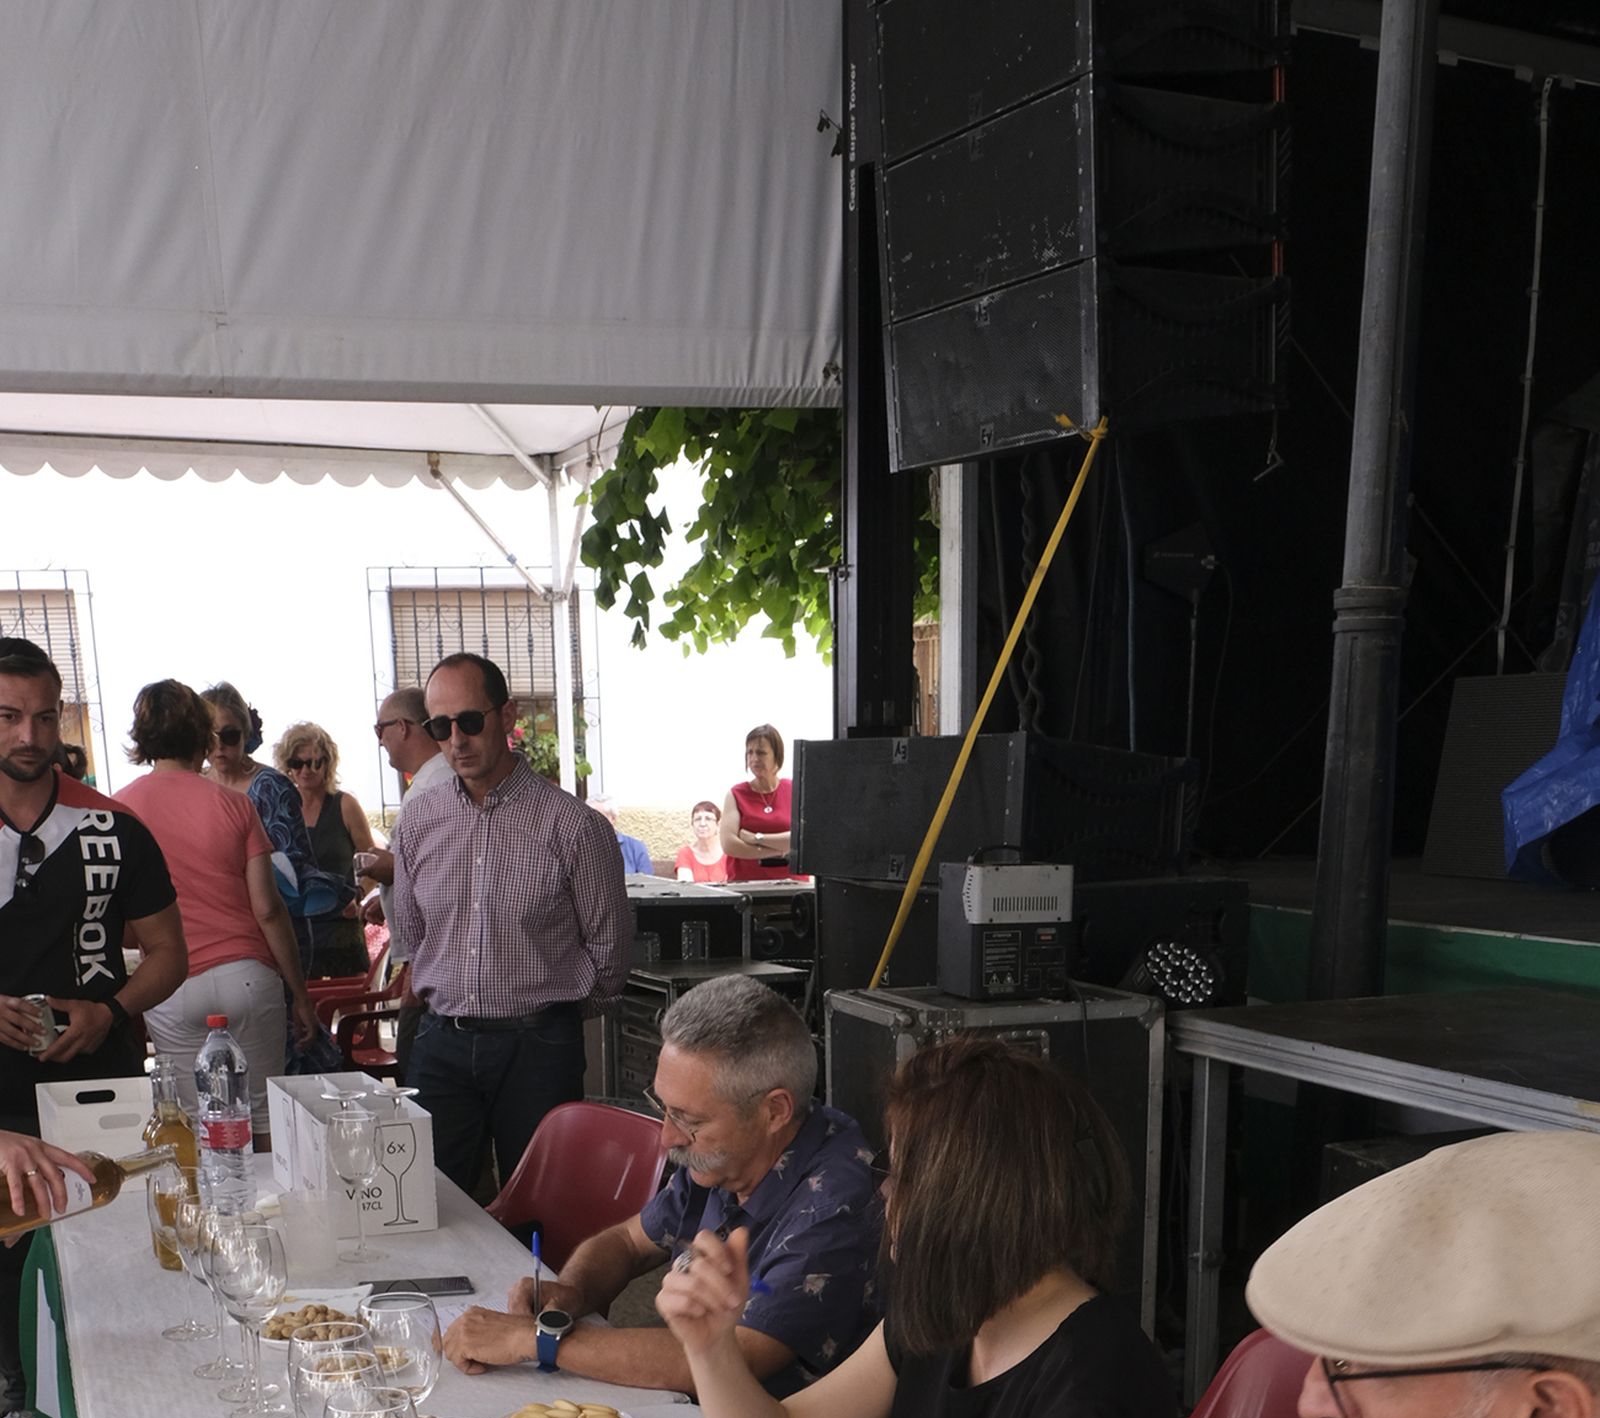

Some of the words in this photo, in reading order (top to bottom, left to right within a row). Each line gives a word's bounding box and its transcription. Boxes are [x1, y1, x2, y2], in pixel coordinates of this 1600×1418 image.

[849, 115, 857, 162] Super
[77, 810, 122, 985] REEBOK
[386, 1141, 406, 1155] 6x
[345, 1186, 383, 1200] VNO
